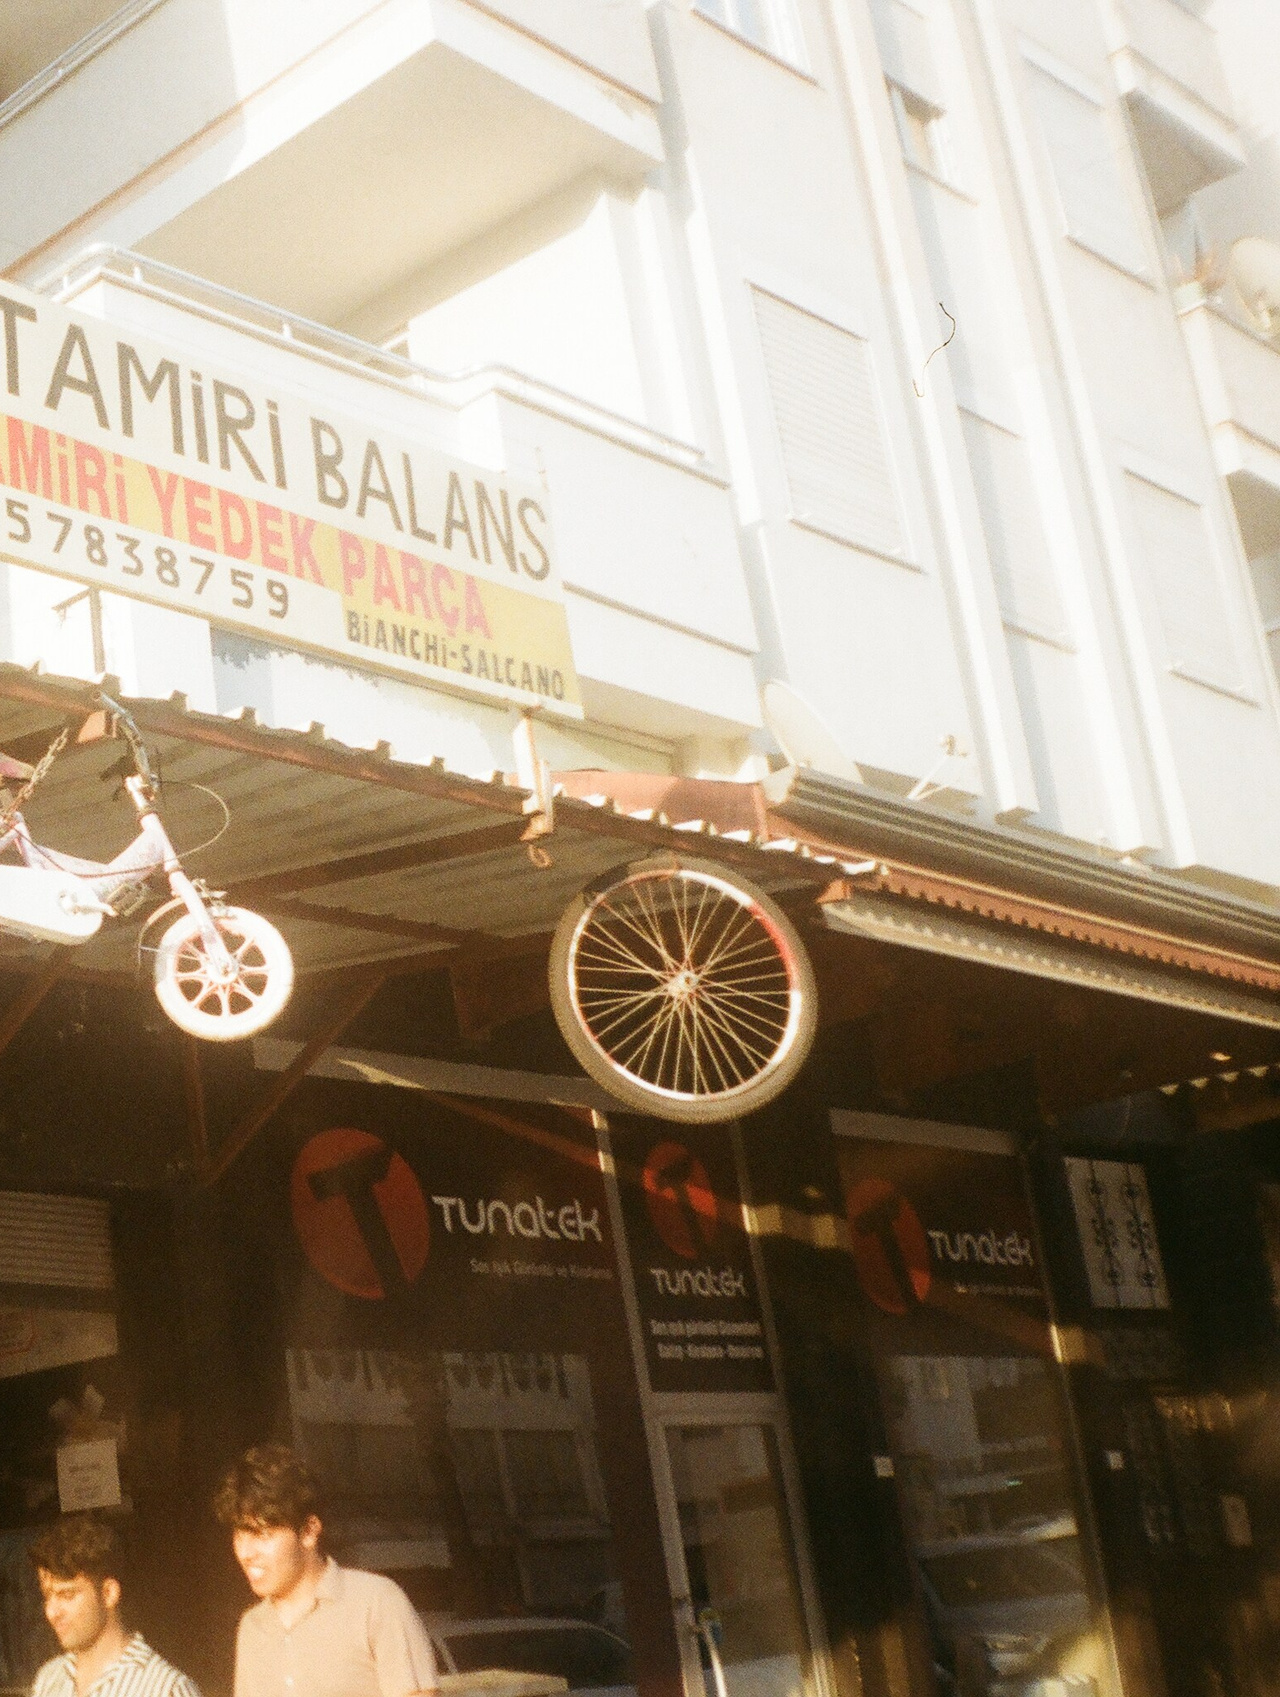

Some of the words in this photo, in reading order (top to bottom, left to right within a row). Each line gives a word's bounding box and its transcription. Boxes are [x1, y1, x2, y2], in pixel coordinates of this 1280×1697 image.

[146, 463, 326, 588] YEDEK
[337, 529, 495, 640] PARÇA
[309, 415, 552, 582] BALANS
